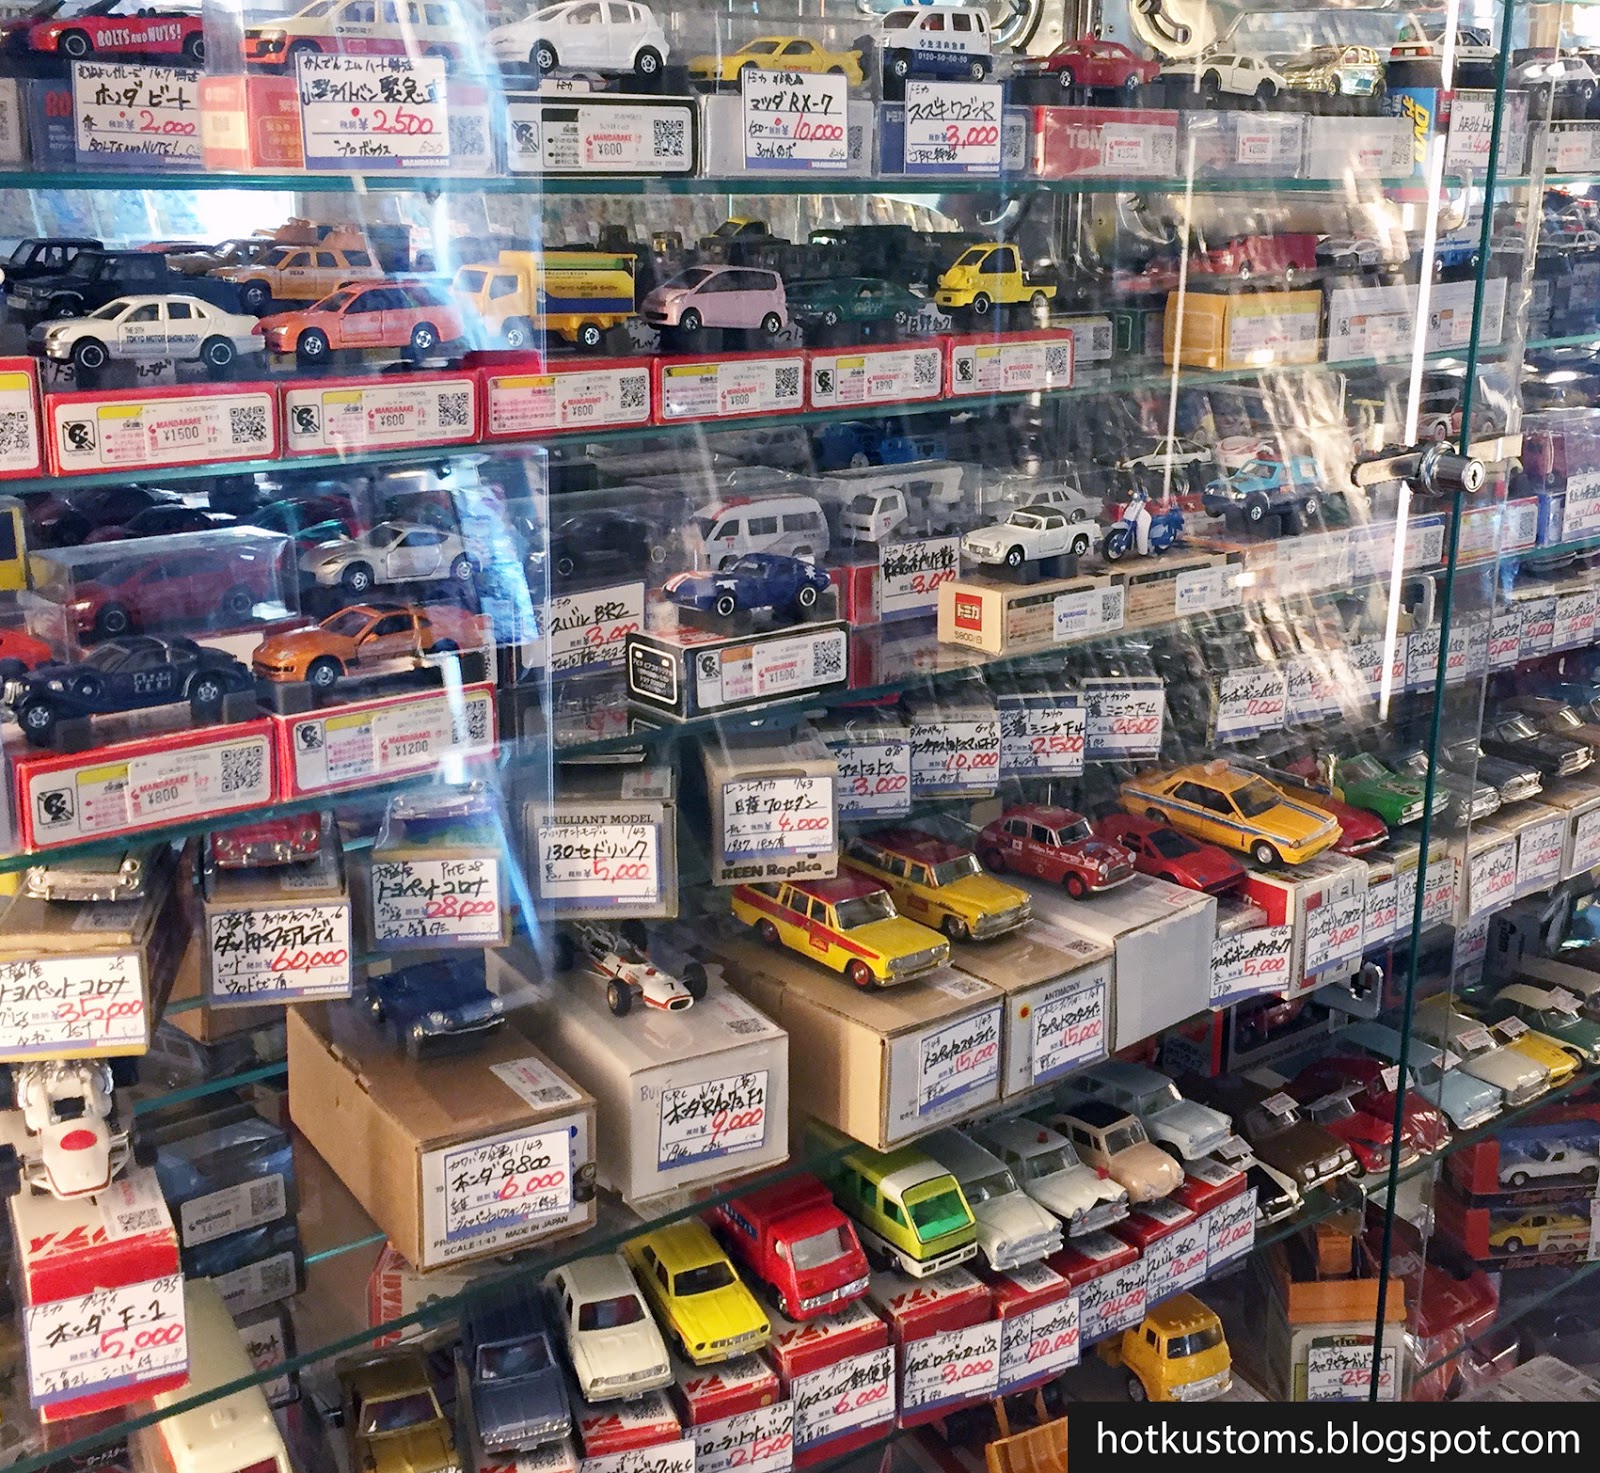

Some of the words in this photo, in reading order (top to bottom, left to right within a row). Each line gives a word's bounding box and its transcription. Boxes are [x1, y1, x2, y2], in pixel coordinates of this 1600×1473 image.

[97, 30, 130, 48] BOLTS
[148, 26, 182, 44] NUTS!
[95, 80, 143, 108] ホンダ
[149, 84, 191, 112] ビート
[750, 90, 787, 110] マツダ
[789, 92, 833, 116] RX-7
[139, 110, 196, 136] 2,000
[372, 106, 433, 135] 2,500
[793, 113, 843, 143] 10,000
[946, 124, 998, 150] 3,000
[157, 416, 202, 429] MANDARAKE
[375, 405, 414, 415] MANDARAKE
[163, 426, 199, 442] ¥1500
[957, 602, 980, 620] トミカ
[1031, 735, 1084, 758] 2,500
[946, 752, 999, 772] 10,000
[139, 774, 189, 794] MANDARAKE
[147, 785, 179, 805] ¥800
[853, 775, 907, 797] 3,000
[542, 815, 607, 825] BRILLIANT
[611, 814, 654, 824] MODEL
[778, 812, 829, 833] 4,000
[546, 839, 648, 861] 130セドリック
[593, 856, 649, 884] 5,000
[767, 861, 822, 877] Replica
[425, 895, 495, 923] 28,000
[271, 947, 348, 973] 60,000
[1243, 957, 1285, 977] 5,000
[57, 994, 144, 1035] 35,000
[1062, 1019, 1101, 1048] 15,000
[955, 1042, 998, 1073] 15,000
[712, 1107, 764, 1143] 9,000
[501, 1154, 551, 1180] S800
[499, 1171, 565, 1201] 6,000
[444, 1243, 475, 1257] SCALE
[505, 1226, 530, 1239] MADE
[531, 1222, 540, 1232] IN
[542, 1215, 569, 1230] JAPAN
[46, 1307, 112, 1349] ホンダ
[100, 1323, 184, 1360] 5,000
[942, 1359, 994, 1385] 3,000
[1341, 1370, 1391, 1388] 2,50
[836, 1383, 888, 1415] 6,000
[730, 1433, 793, 1468] 2,500
